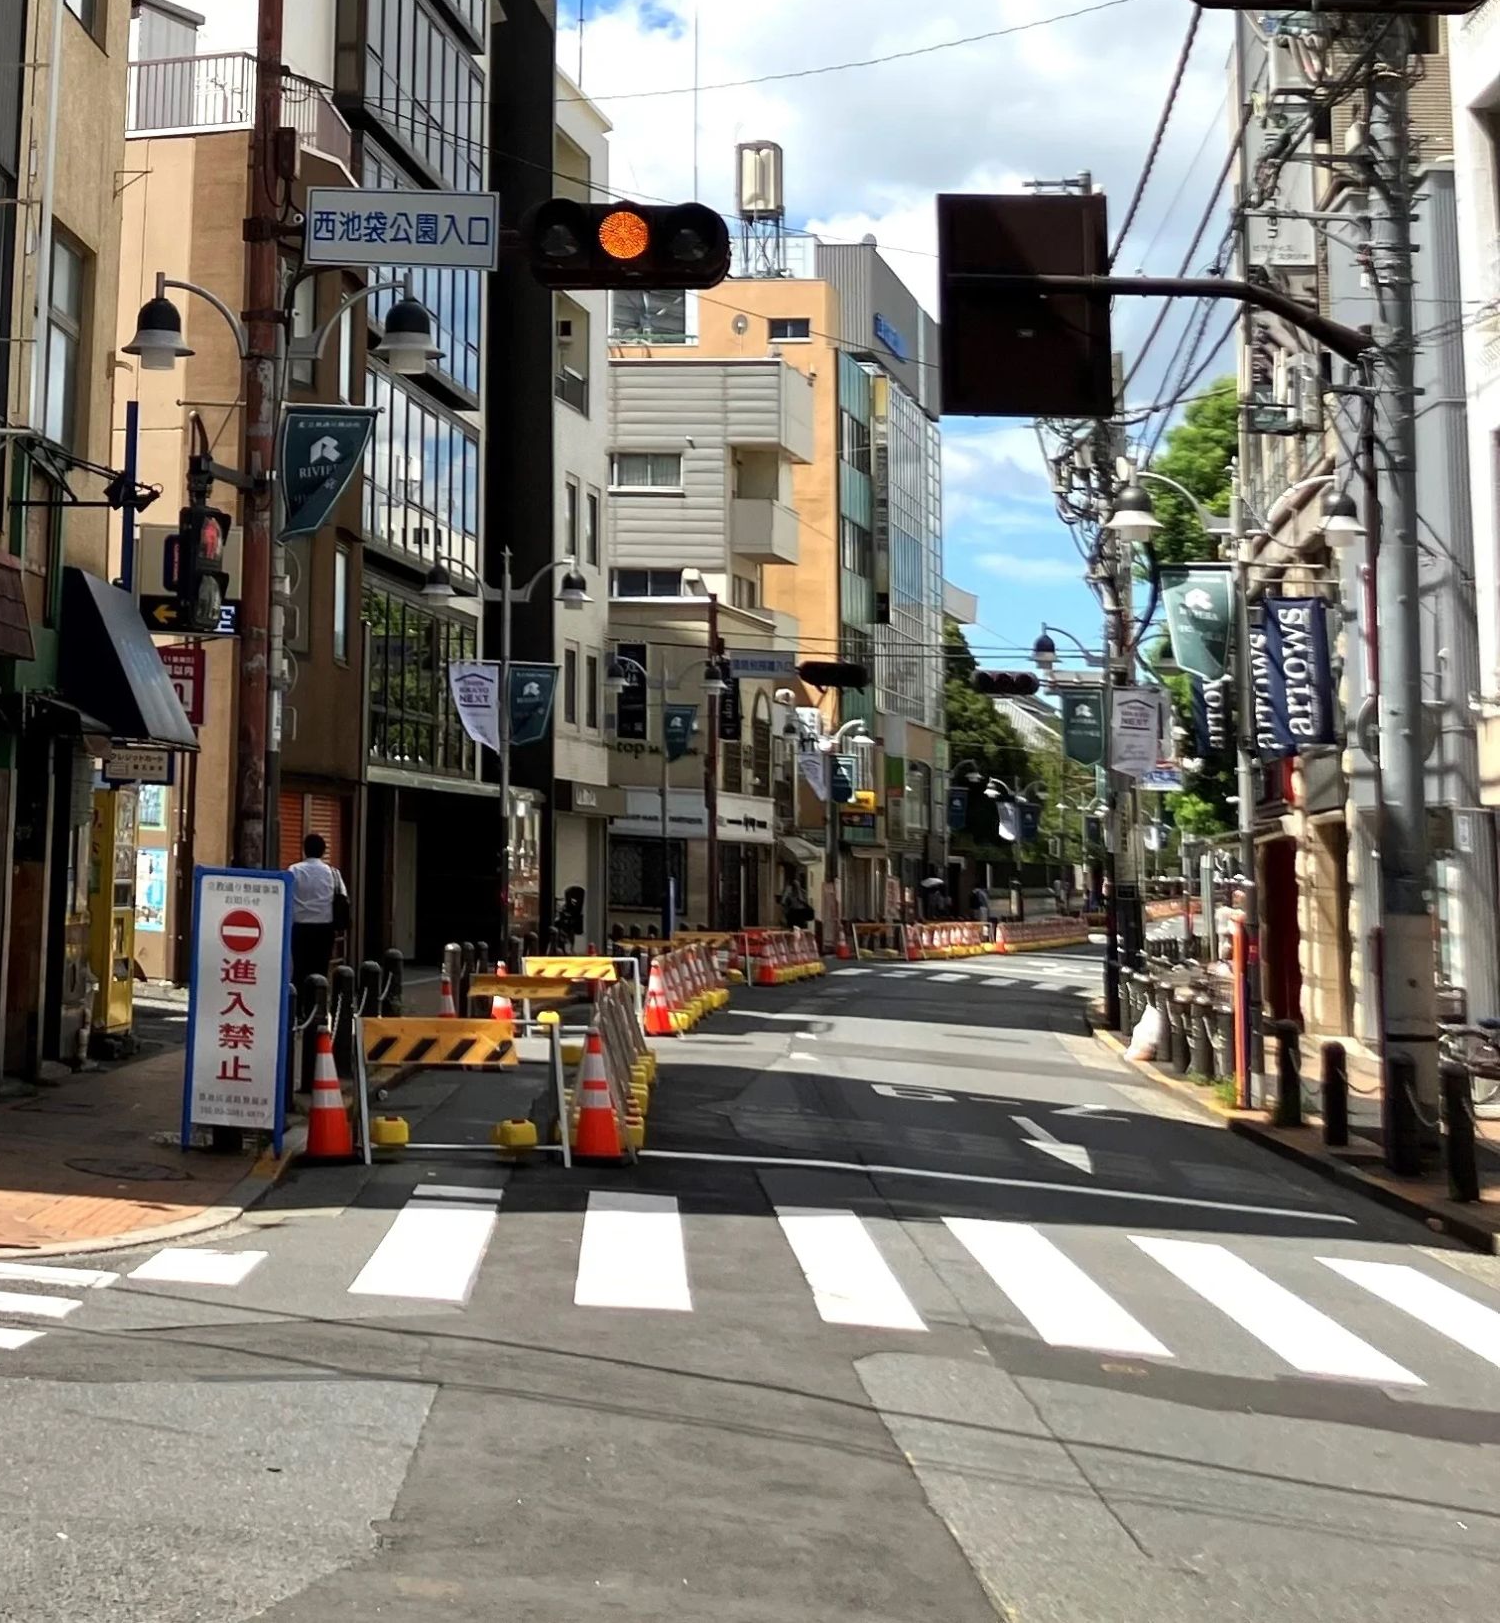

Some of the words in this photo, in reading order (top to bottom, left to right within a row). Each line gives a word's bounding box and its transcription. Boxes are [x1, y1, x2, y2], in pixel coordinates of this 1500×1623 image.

[313, 211, 490, 245] 西池袋公園入口
[459, 694, 489, 703] NEXT
[1277, 607, 1315, 737] arrows
[215, 958, 258, 1083] 進入禁止
